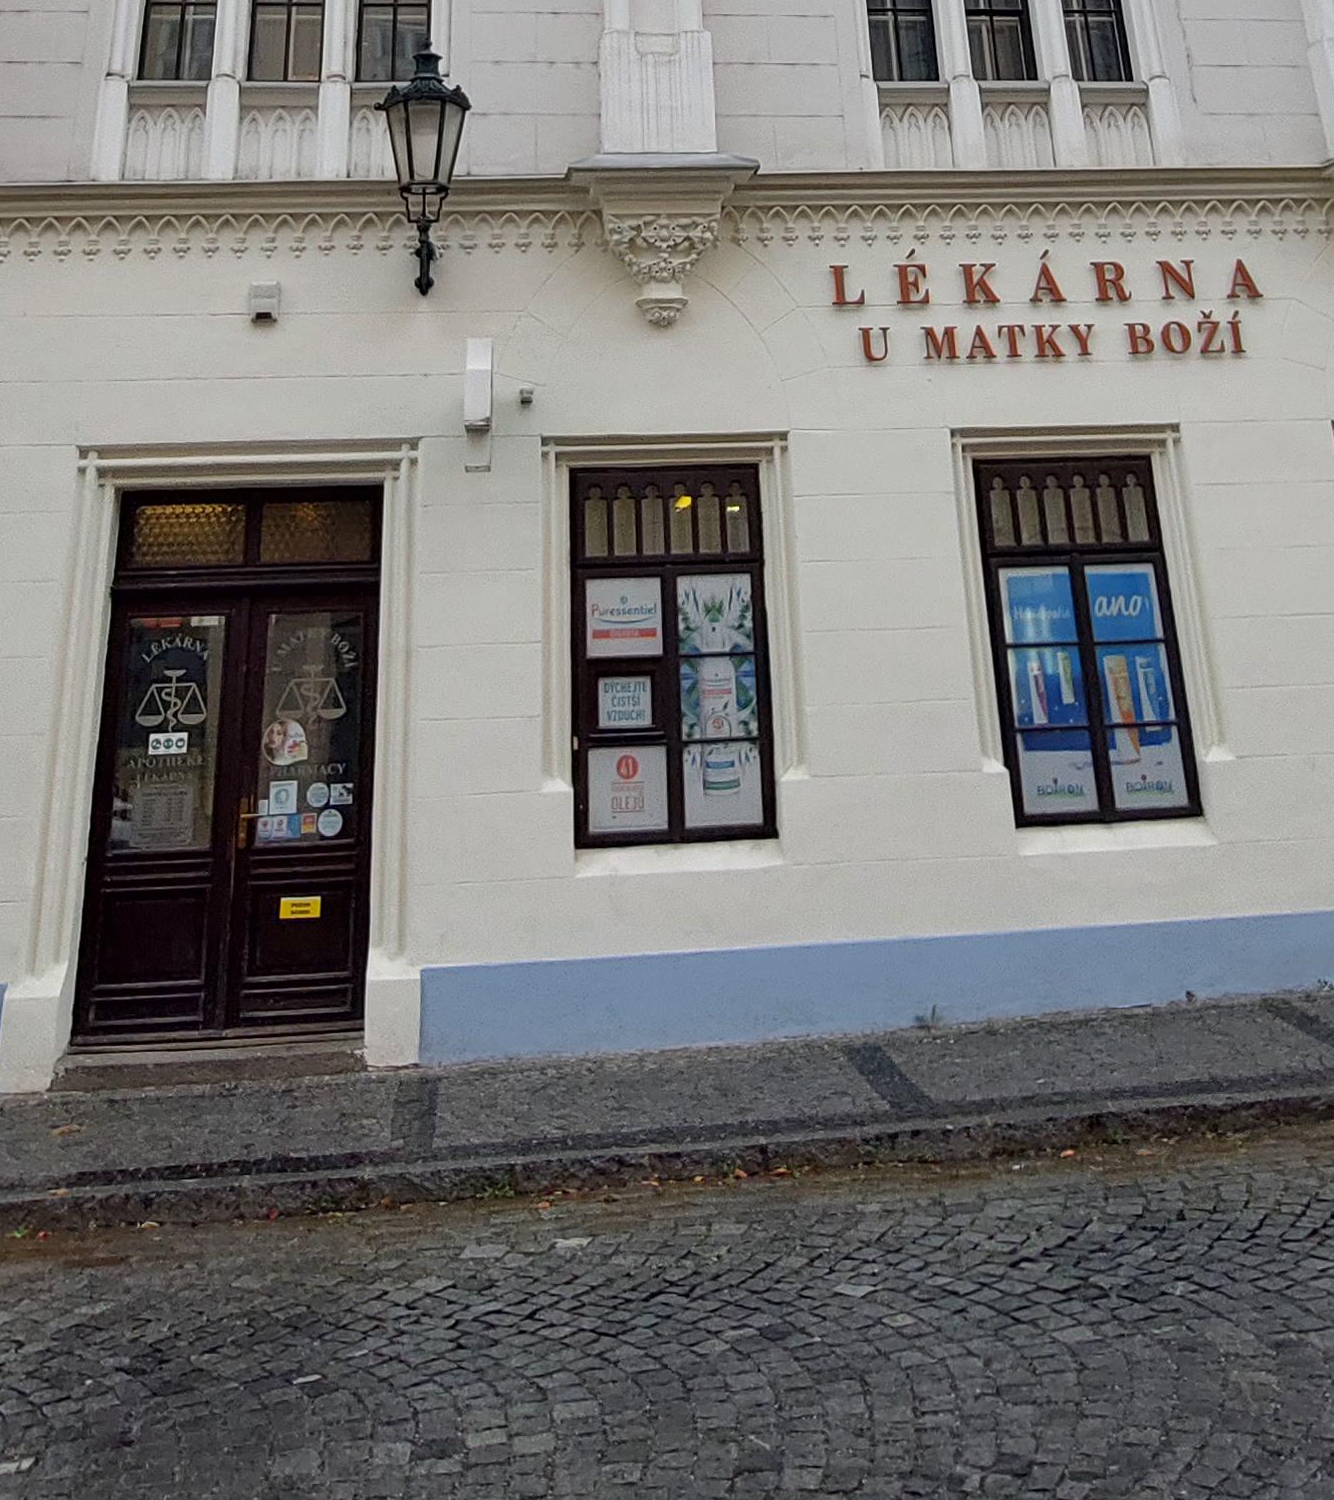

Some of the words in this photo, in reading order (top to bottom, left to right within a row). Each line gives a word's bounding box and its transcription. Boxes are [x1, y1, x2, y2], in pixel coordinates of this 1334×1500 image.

[828, 248, 1264, 305] LÉKÁRNA
[858, 326, 890, 362] U
[920, 322, 1095, 360] MATKY
[1124, 310, 1247, 355] BOŽÍ
[591, 602, 657, 617] Puressentiel
